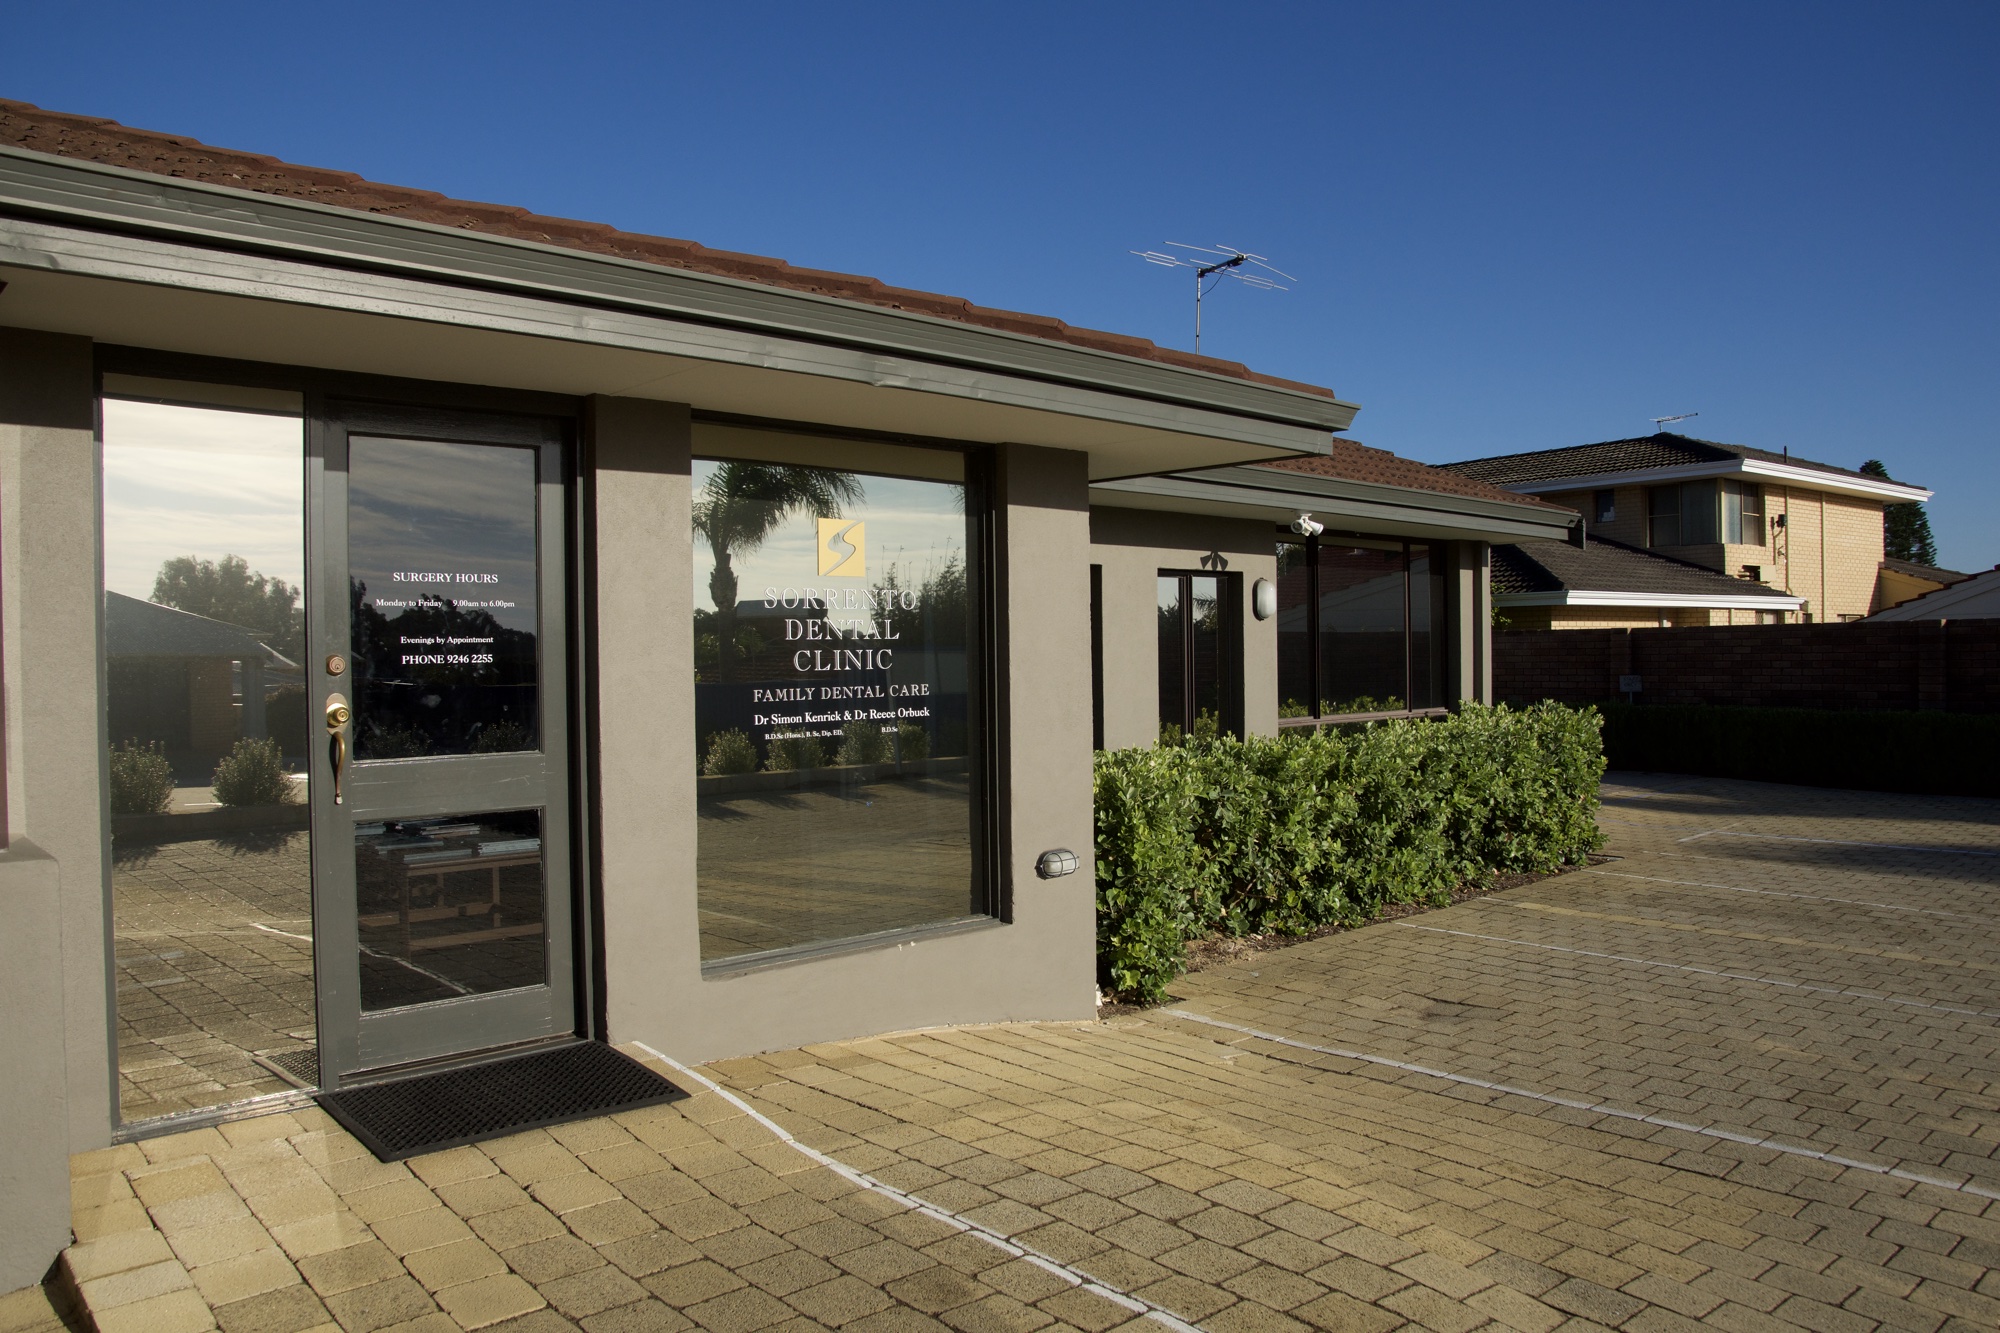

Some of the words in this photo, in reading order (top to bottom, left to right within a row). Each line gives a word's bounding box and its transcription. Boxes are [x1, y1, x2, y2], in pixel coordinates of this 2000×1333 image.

[393, 572, 453, 583] SURGERY
[455, 573, 499, 584] HOURS
[376, 599, 407, 608] Monday
[418, 599, 443, 608] Friday
[489, 600, 515, 609] 6.00pm
[763, 586, 917, 611] SORRENTO
[784, 618, 901, 641] DENTAL
[400, 636, 435, 645] Evenings
[436, 636, 446, 645] by
[446, 636, 494, 645] Appointment
[401, 654, 445, 665] PHONE
[446, 654, 470, 664] 9246
[471, 654, 494, 664] 2255
[793, 648, 894, 672] CLINIC
[753, 687, 816, 703] FAMILY
[821, 685, 885, 700] DENTAL
[889, 683, 930, 697] CARE
[754, 714, 769, 726] Dr
[771, 713, 802, 725] Simon
[804, 711, 841, 723] Kenrick
[843, 710, 852, 721] &
[854, 709, 868, 720] Dr
[869, 708, 896, 720] Reece
[897, 707, 930, 718] Orbuck
